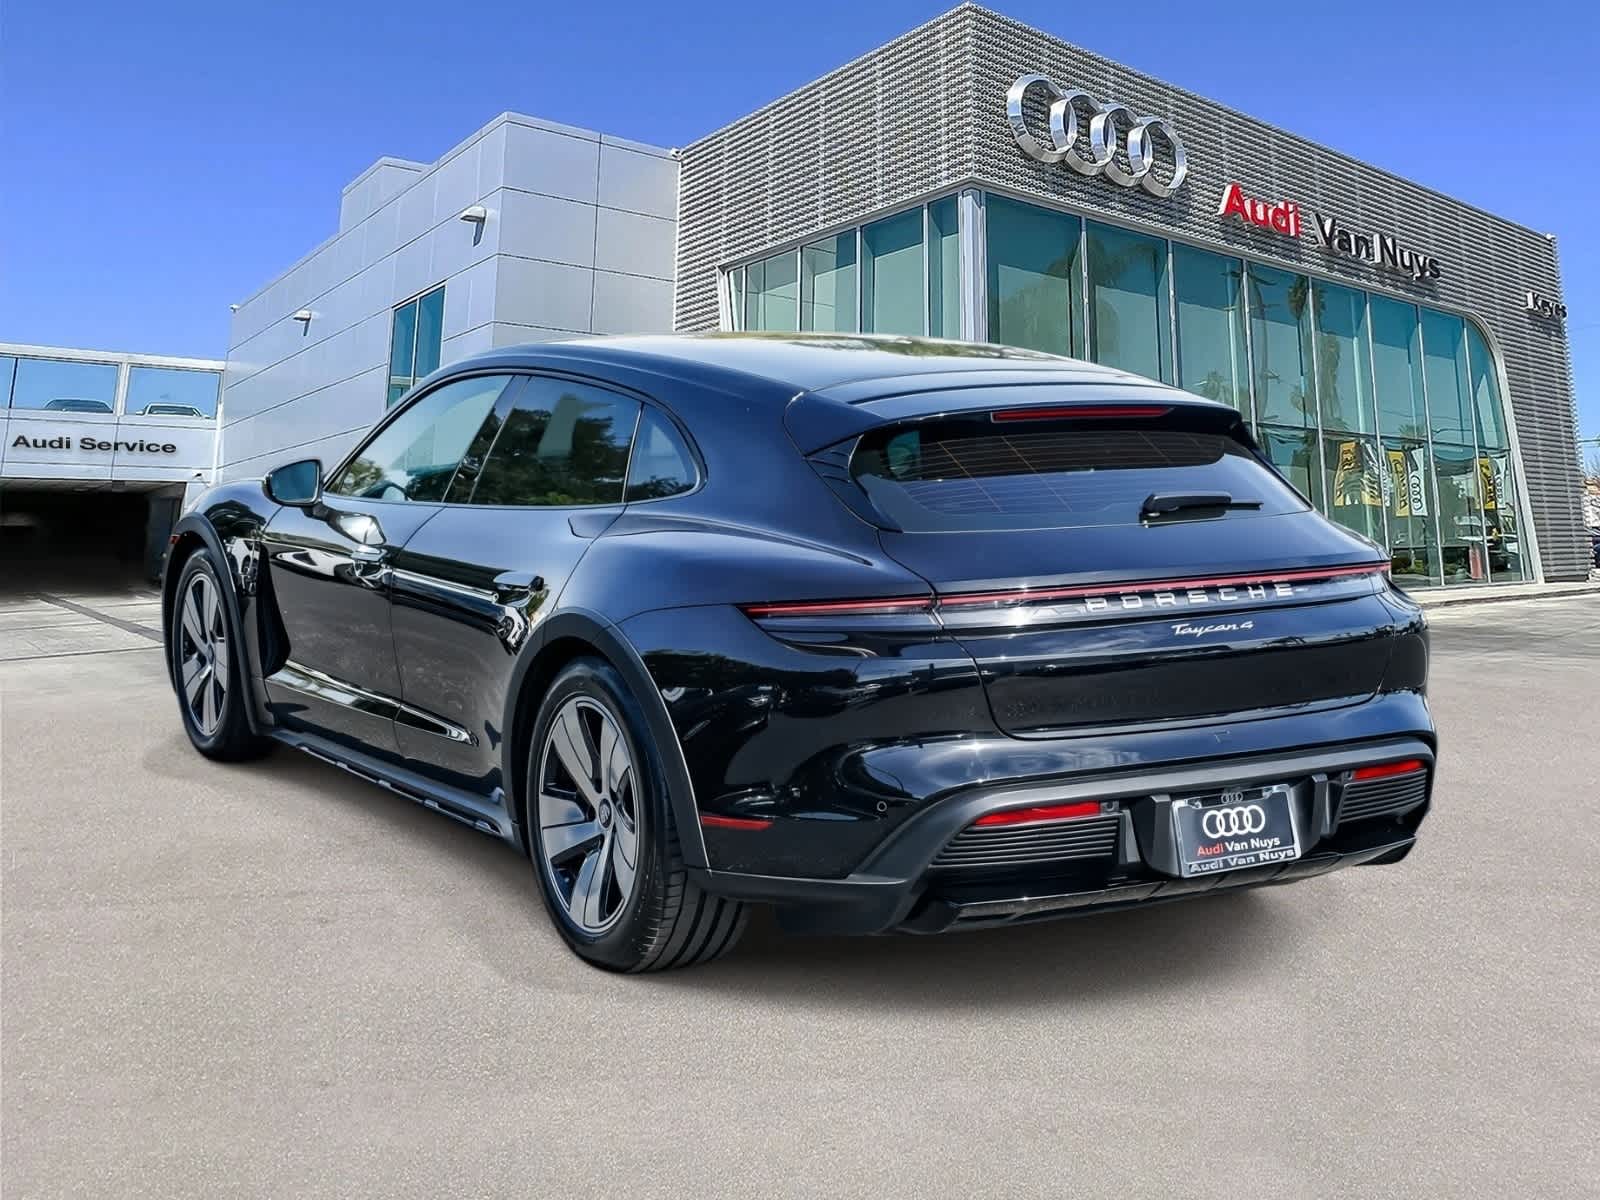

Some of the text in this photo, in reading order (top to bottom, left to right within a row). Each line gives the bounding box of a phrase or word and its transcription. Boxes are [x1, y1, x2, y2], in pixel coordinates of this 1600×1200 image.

[1219, 182, 1441, 280] Audi Van Nuys
[12, 435, 177, 454] Audi Service
[1084, 582, 1293, 612] PORSCHE
[1171, 622, 1236, 637] Taycan
[1197, 837, 1280, 856] Audi Van Nuys
[1190, 849, 1295, 873] Audi Van Nuys
